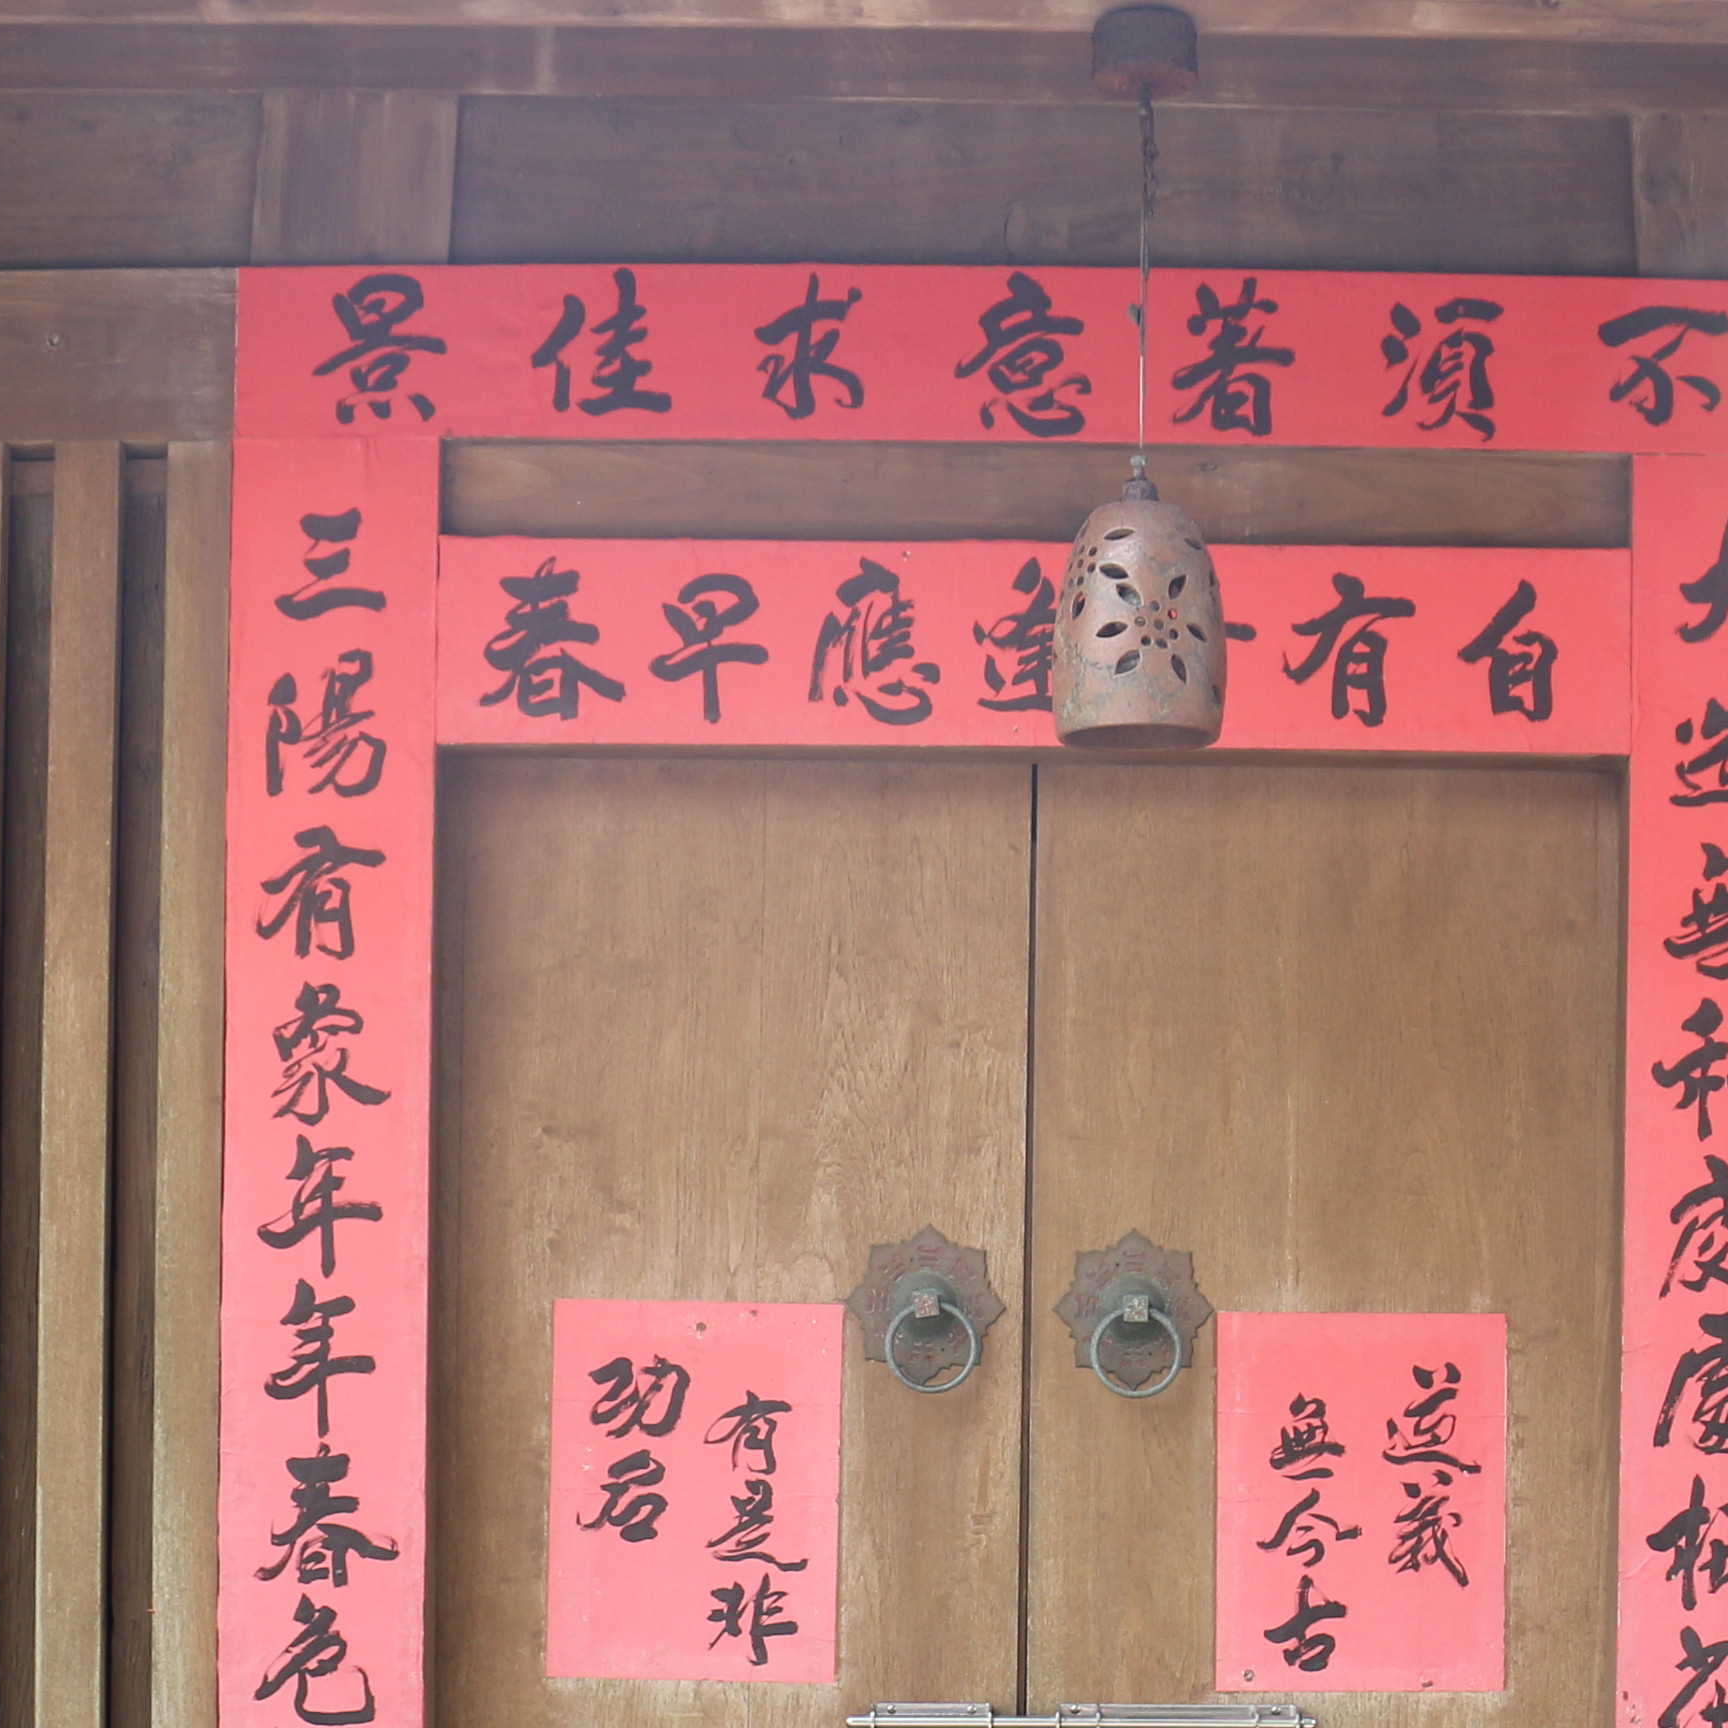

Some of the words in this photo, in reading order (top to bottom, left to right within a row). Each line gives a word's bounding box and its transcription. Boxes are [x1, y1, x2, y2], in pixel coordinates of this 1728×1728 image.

[479, 556, 1561, 727] 自有逢應早春
[704, 1390, 809, 1664] 有是非
[1256, 1392, 1363, 1673] 無今古
